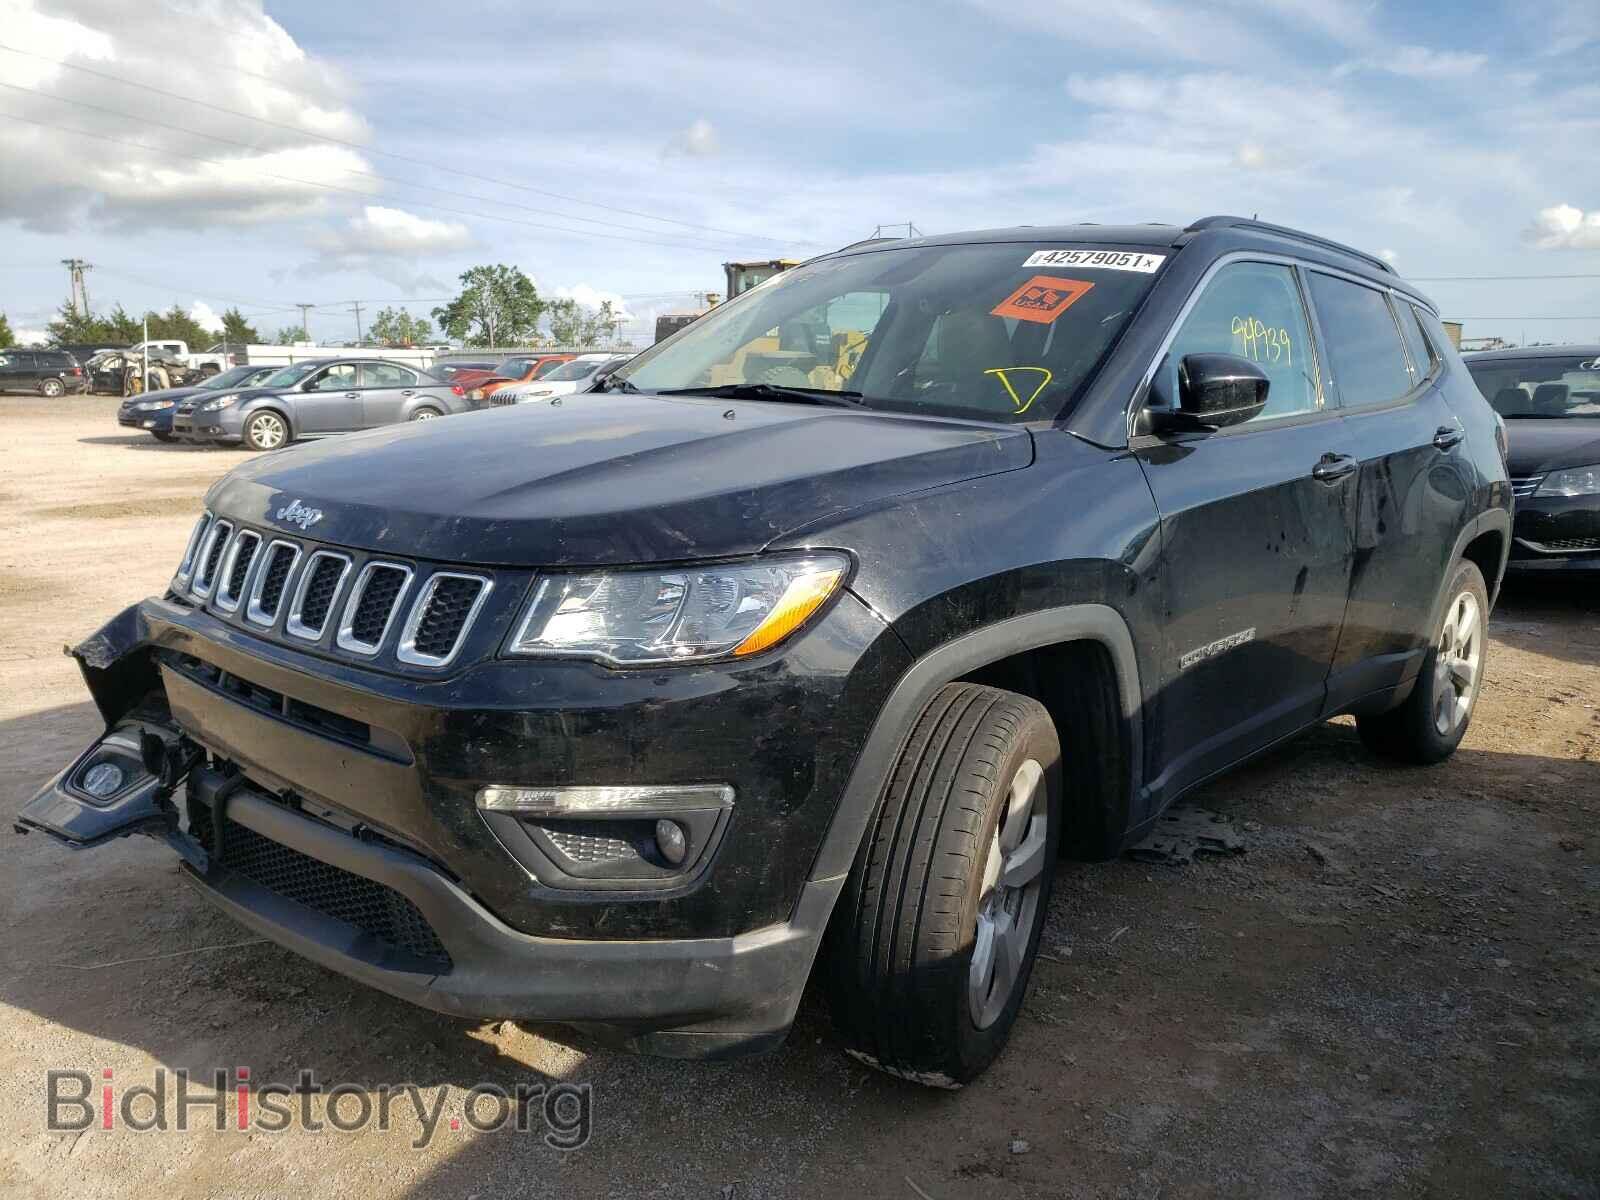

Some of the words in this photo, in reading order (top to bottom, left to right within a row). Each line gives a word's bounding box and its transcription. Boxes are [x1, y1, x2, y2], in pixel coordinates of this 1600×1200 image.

[1043, 251, 1144, 268] 42579051
[1231, 315, 1293, 368] 94939
[276, 499, 323, 530] Jeep
